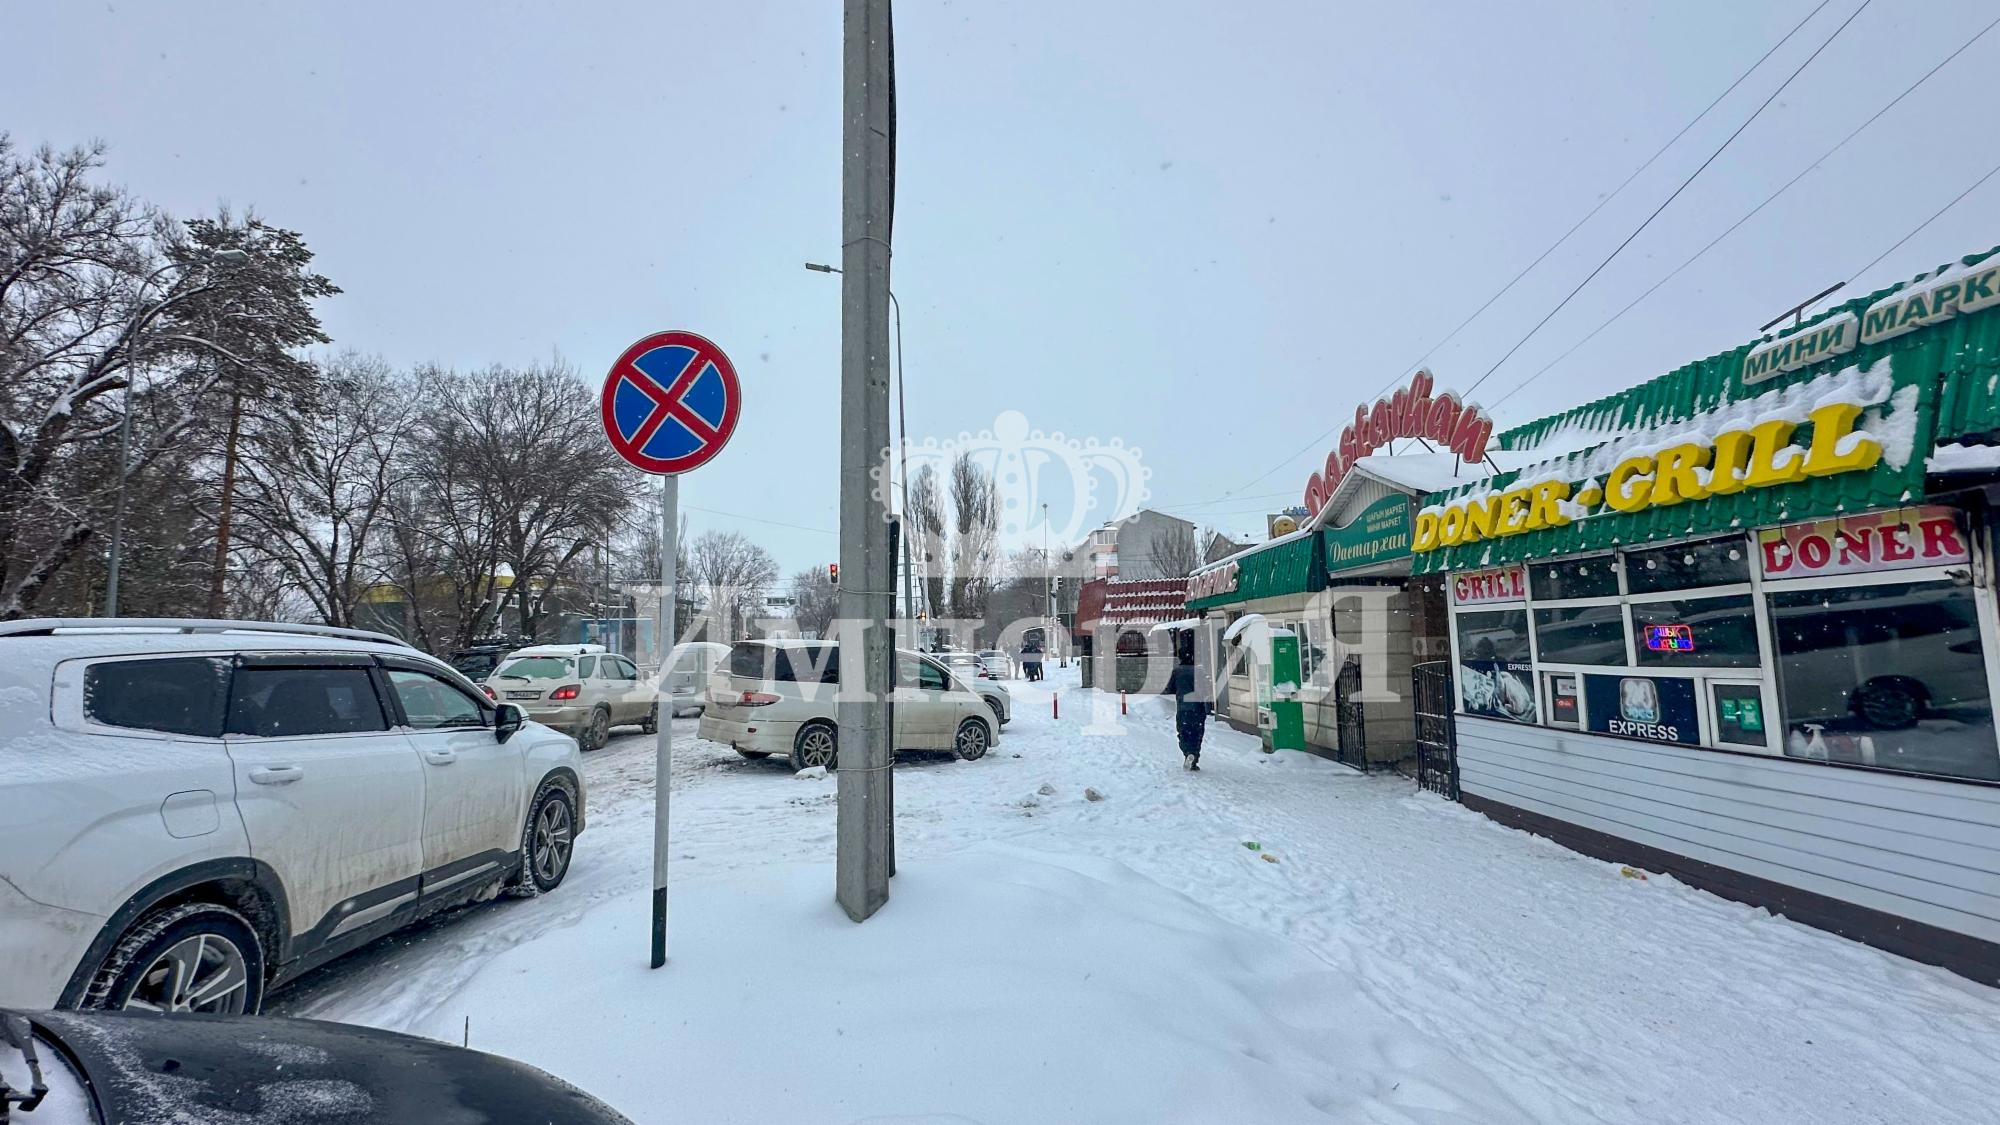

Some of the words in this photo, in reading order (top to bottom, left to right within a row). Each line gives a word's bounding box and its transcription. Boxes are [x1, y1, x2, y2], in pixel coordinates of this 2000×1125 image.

[1744, 323, 1846, 379] МИНИ
[1864, 266, 2000, 337] МАРК
[1411, 481, 1572, 552] DONER
[1605, 402, 1882, 514] GRILL
[1761, 517, 1966, 574] DONER
[1454, 570, 1526, 601] GRILL
[1608, 719, 1679, 741] EXPRESS
